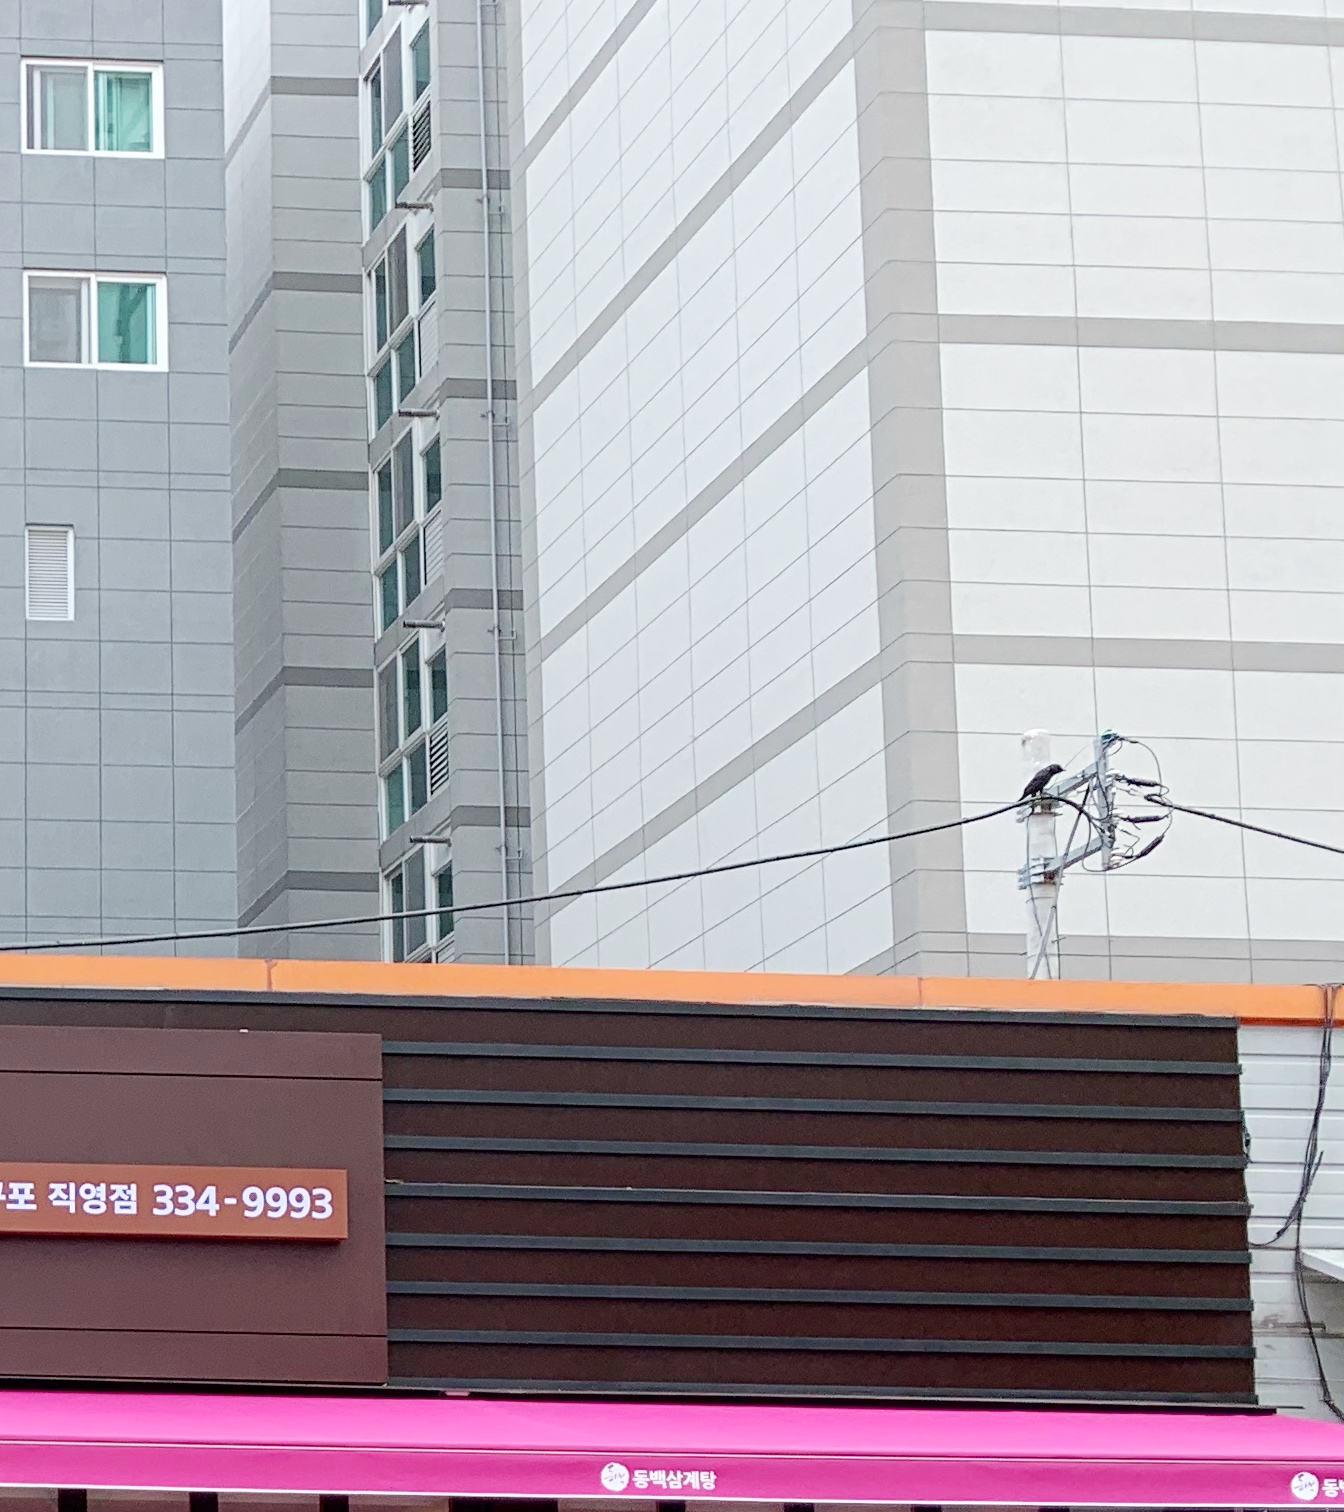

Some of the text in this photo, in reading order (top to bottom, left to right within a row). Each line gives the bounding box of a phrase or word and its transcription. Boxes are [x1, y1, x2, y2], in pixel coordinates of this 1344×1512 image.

[48, 1182, 138, 1215] 직영점
[152, 1184, 334, 1219] 334-9993
[632, 1469, 718, 1491] 동백삼계탕
